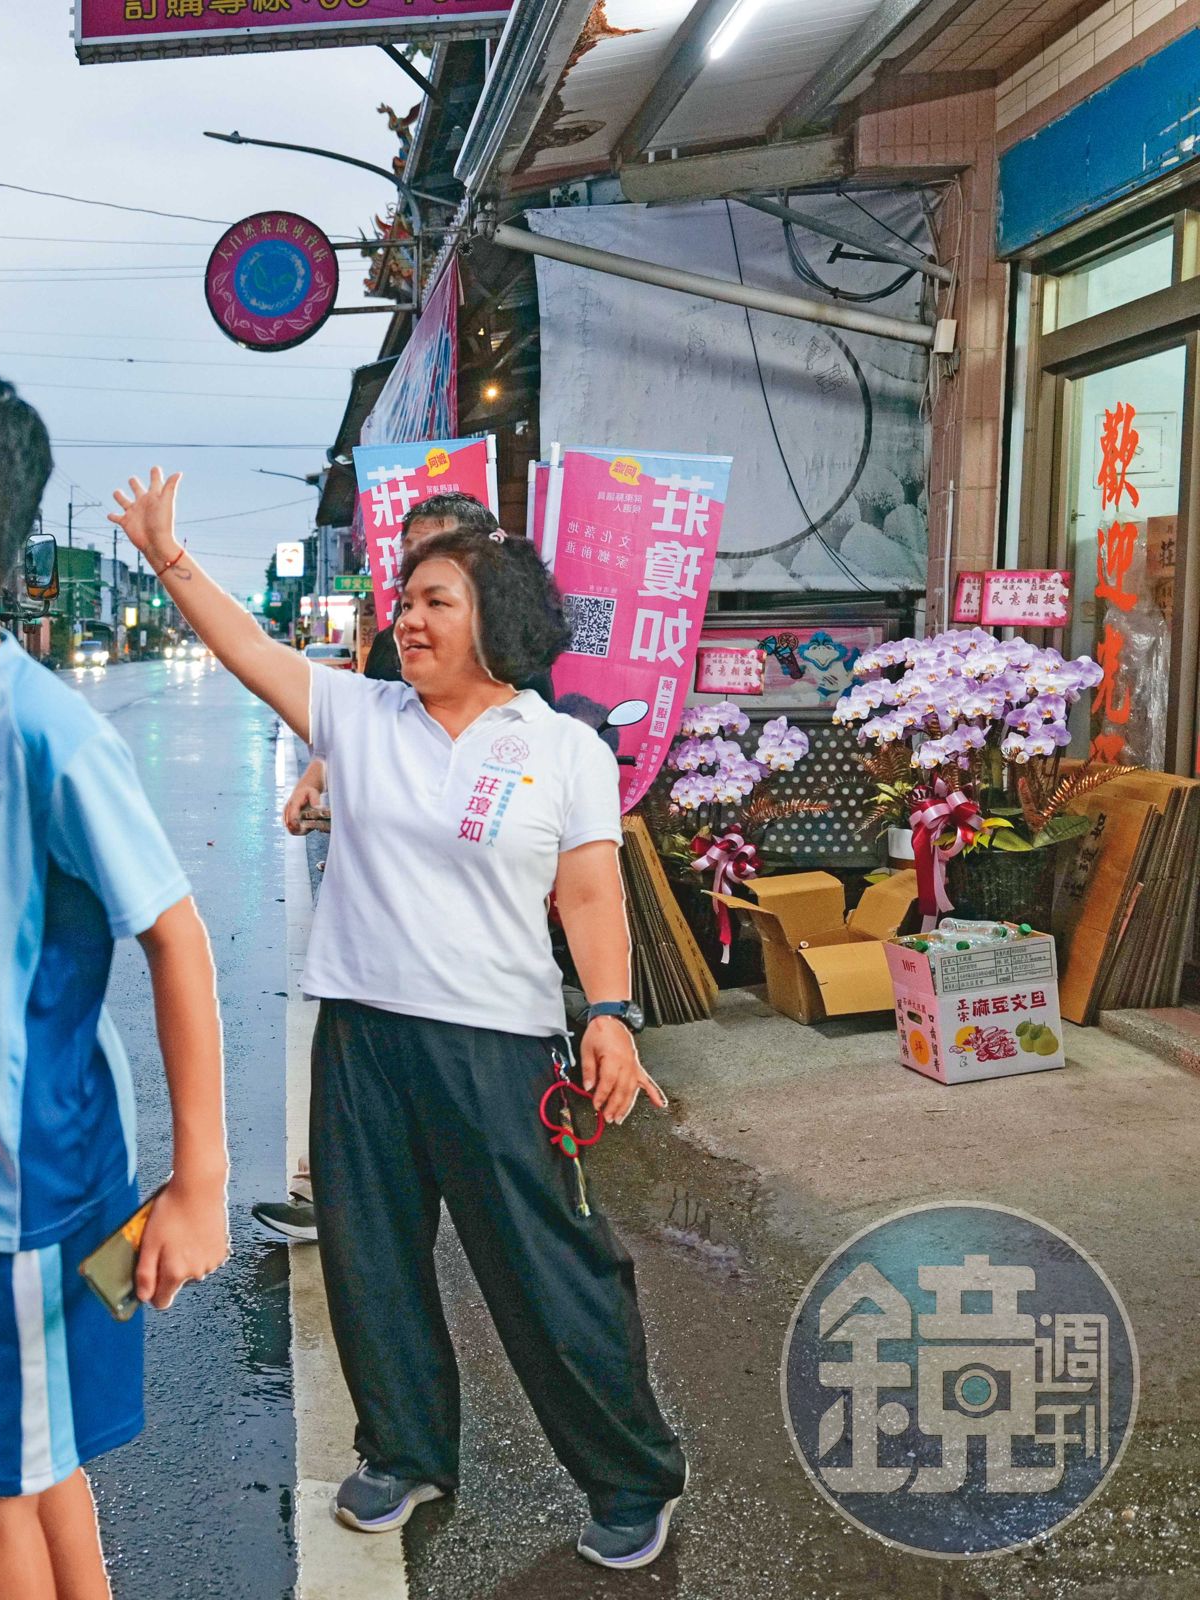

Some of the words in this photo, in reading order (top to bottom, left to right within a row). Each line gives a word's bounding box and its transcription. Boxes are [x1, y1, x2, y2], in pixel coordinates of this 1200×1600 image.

[458, 776, 501, 842] 莊瓊如
[972, 990, 1047, 1017] 麻豆文旦
